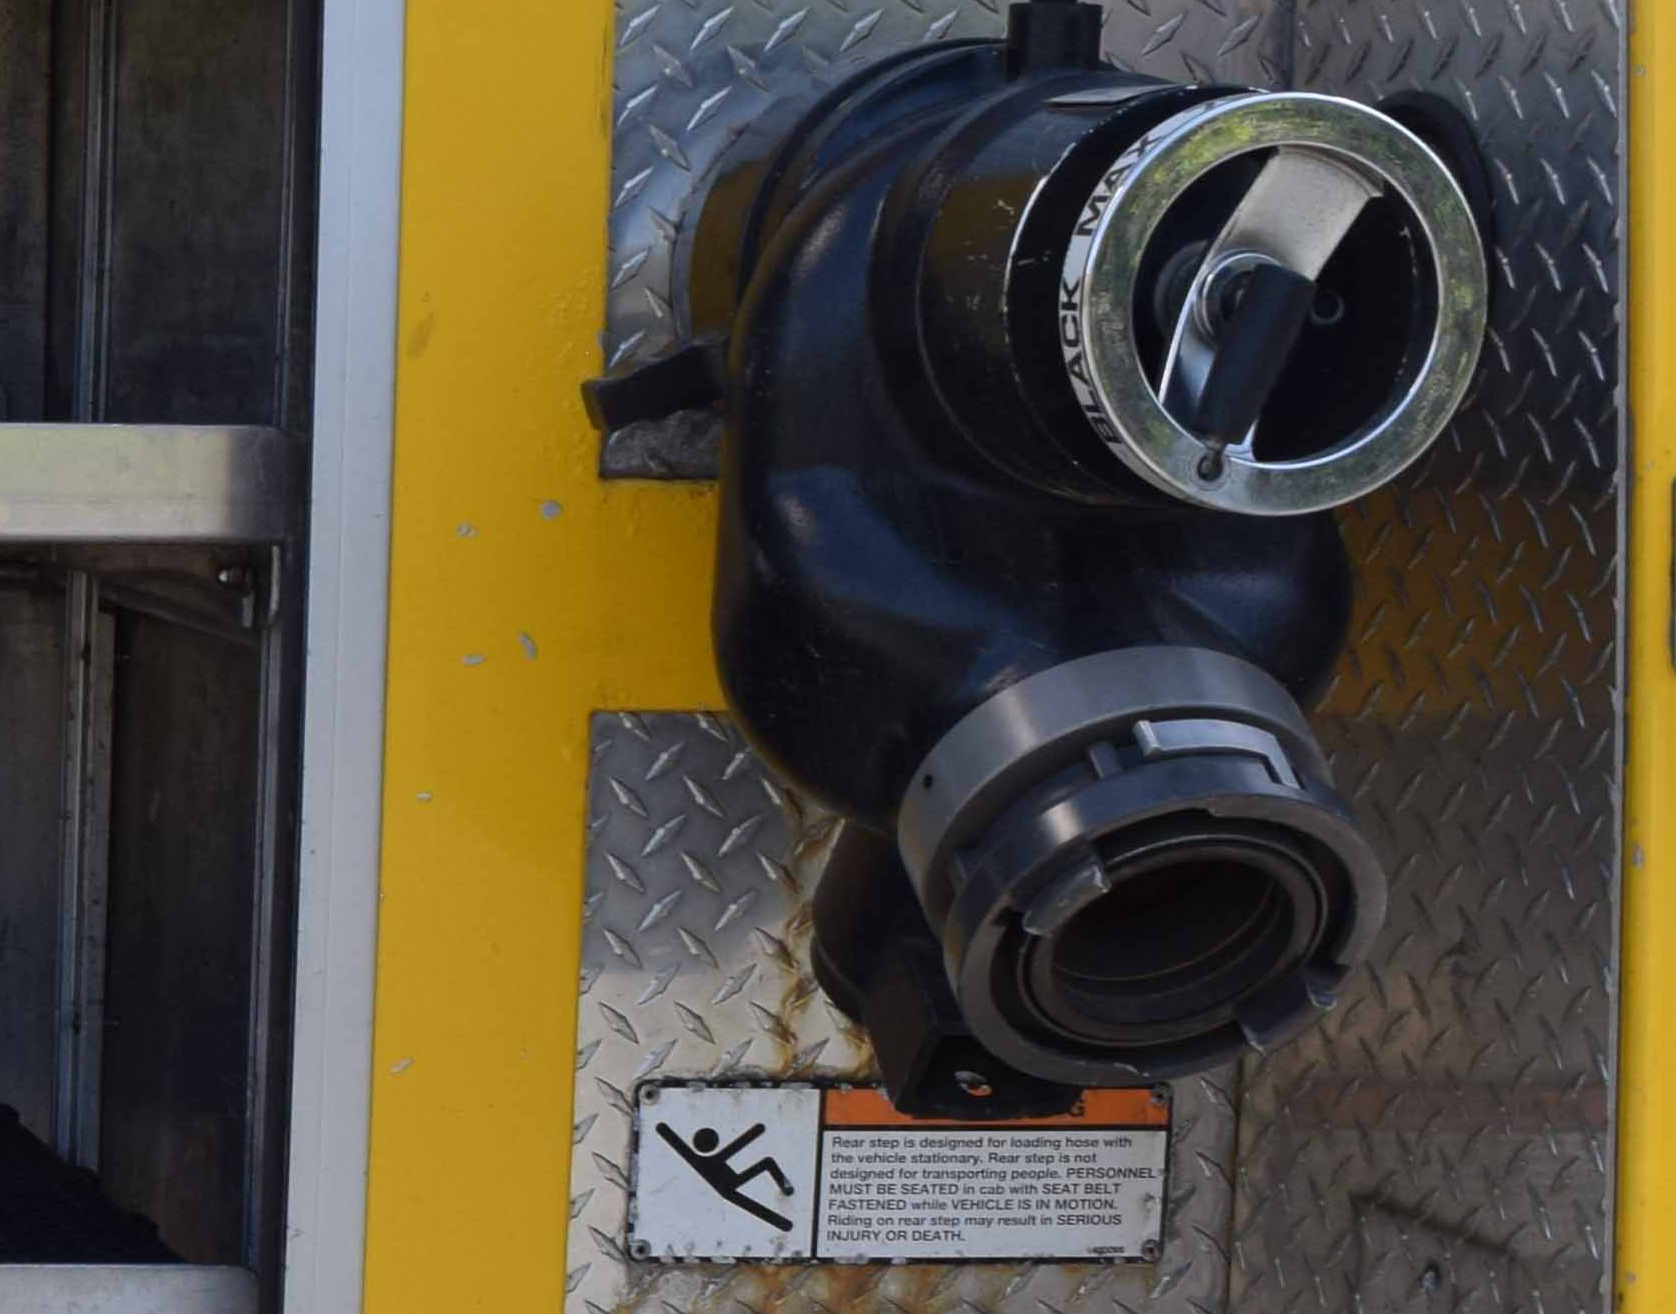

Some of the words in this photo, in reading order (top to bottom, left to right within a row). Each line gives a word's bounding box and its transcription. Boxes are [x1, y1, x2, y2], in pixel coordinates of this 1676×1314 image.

[1077, 136, 1165, 237] MAX
[1060, 276, 1124, 445] BLACK
[831, 1137, 866, 1148] Rear
[869, 1137, 901, 1151] step
[903, 1137, 916, 1148] is
[918, 1137, 984, 1151] designed
[987, 1137, 1008, 1148] for
[1009, 1137, 1063, 1151] loading
[1065, 1137, 1100, 1148] hose
[1102, 1137, 1133, 1148] with
[831, 1153, 855, 1164] the
[856, 1153, 908, 1164] vehicle
[910, 1153, 984, 1167] stationary.
[987, 1153, 1022, 1164] Rear
[1024, 1153, 1055, 1167] step
[1058, 1153, 1071, 1164] is
[1073, 1153, 1097, 1164] not
[829, 1168, 896, 1182] designed
[898, 1168, 919, 1179] for
[921, 1168, 1008, 1182] transporting
[1010, 1168, 1062, 1182] people.
[1065, 1168, 1157, 1179] PERSONNEL
[829, 1183, 874, 1195] MUST
[875, 1183, 899, 1195] BE
[899, 1183, 960, 1195] SEATED
[962, 1183, 976, 1195] in
[978, 1183, 1006, 1195] cab
[1008, 1183, 1039, 1195] with
[1041, 1183, 1082, 1195] SEAT
[1083, 1183, 1122, 1195] BELT
[827, 1199, 907, 1210] FASTENED
[910, 1199, 948, 1210] while
[950, 1199, 1015, 1210] VEHICLE
[1017, 1199, 1033, 1210] IS
[1035, 1199, 1051, 1210] IN
[1054, 1199, 1118, 1210] MOTION.
[826, 1214, 873, 1229] Riding
[875, 1217, 895, 1226] on
[897, 1217, 927, 1226] rear
[929, 1214, 961, 1229] step
[963, 1217, 995, 1229] may
[996, 1214, 1037, 1226] result
[1040, 1214, 1053, 1226] in
[1056, 1214, 1123, 1226] SERIOUS
[825, 1230, 881, 1242] INJURY
[884, 1230, 908, 1242] OR
[911, 1230, 966, 1242] DEATH.
